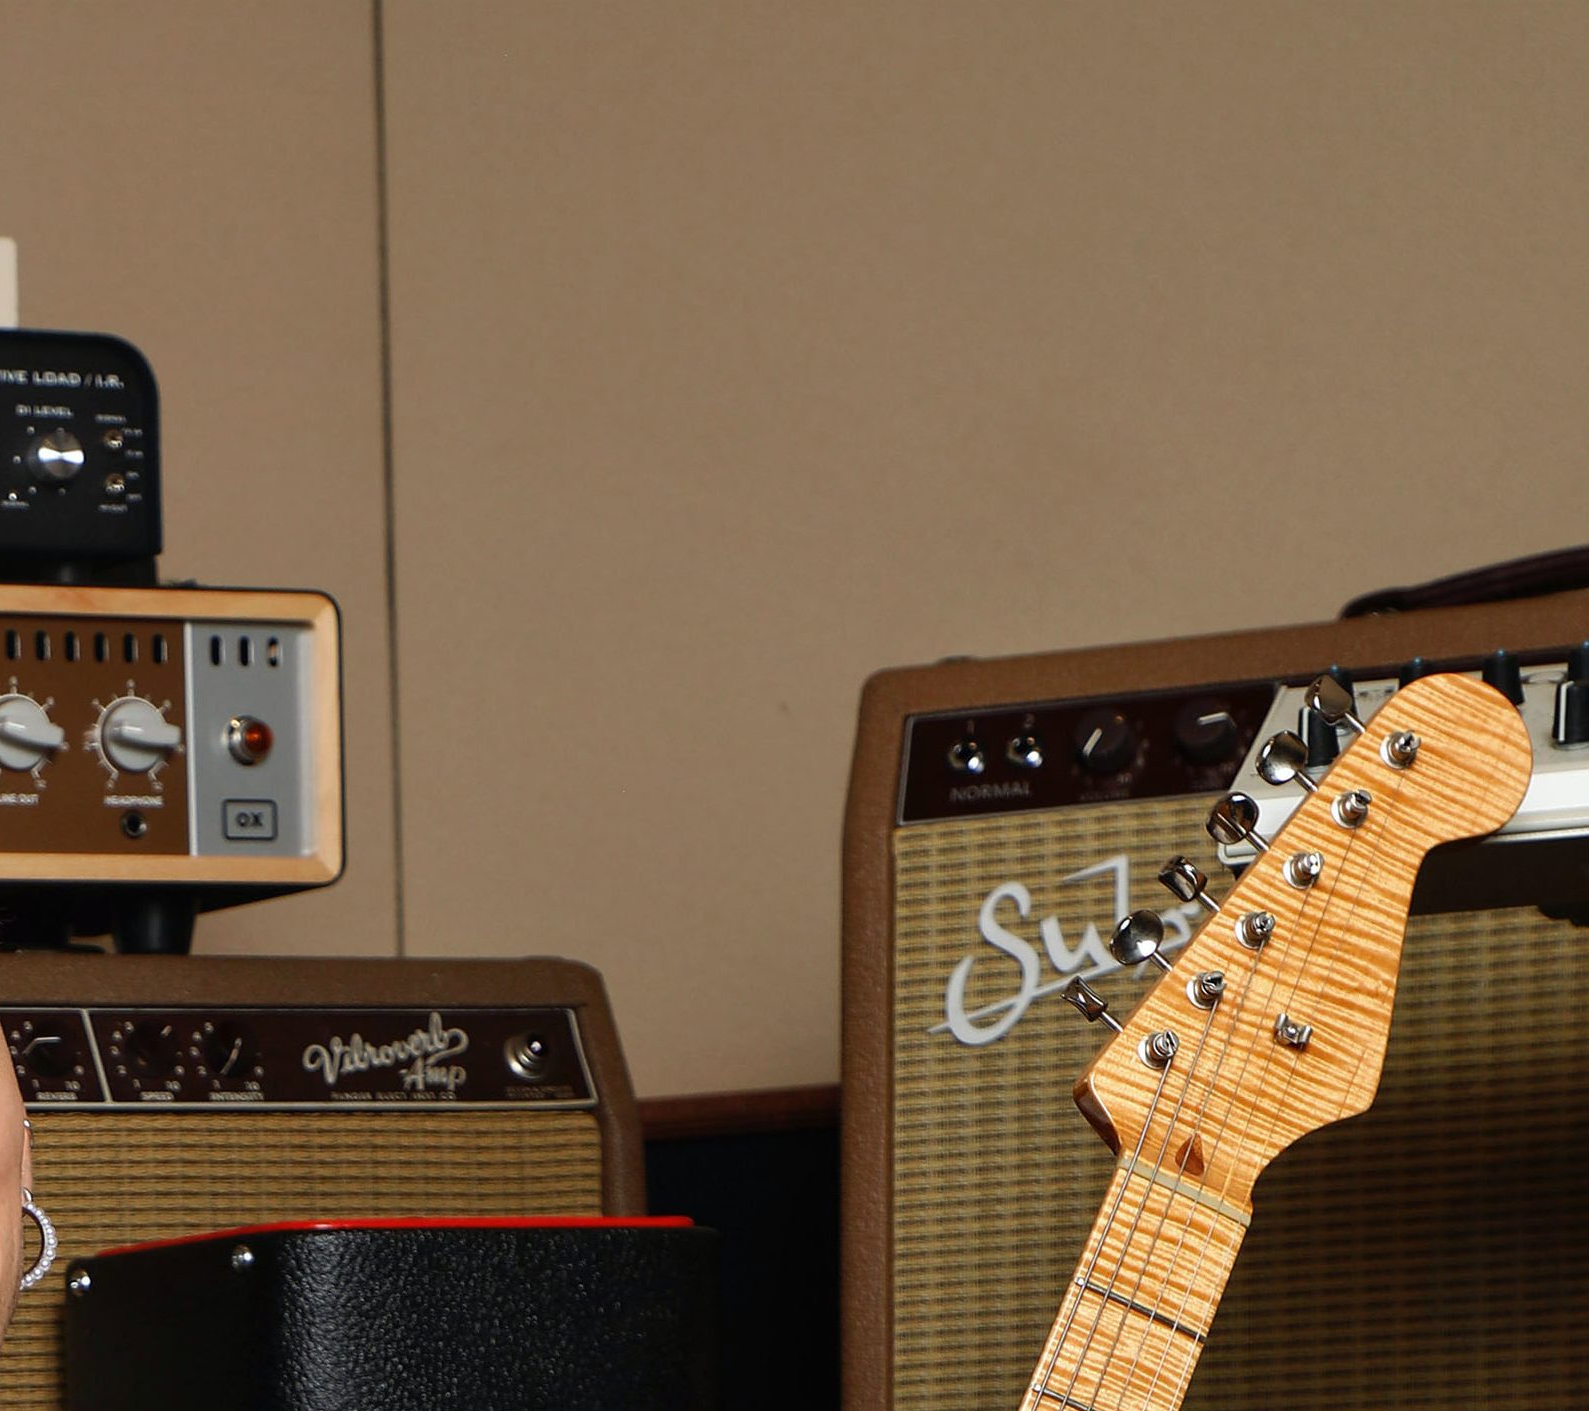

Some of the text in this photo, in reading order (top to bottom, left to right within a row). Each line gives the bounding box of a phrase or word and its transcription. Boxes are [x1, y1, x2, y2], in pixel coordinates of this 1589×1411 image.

[33, 370, 82, 387] LOAD
[35, 405, 75, 418] LEVEL
[949, 780, 1034, 803] NORMAL
[235, 812, 264, 828] OX
